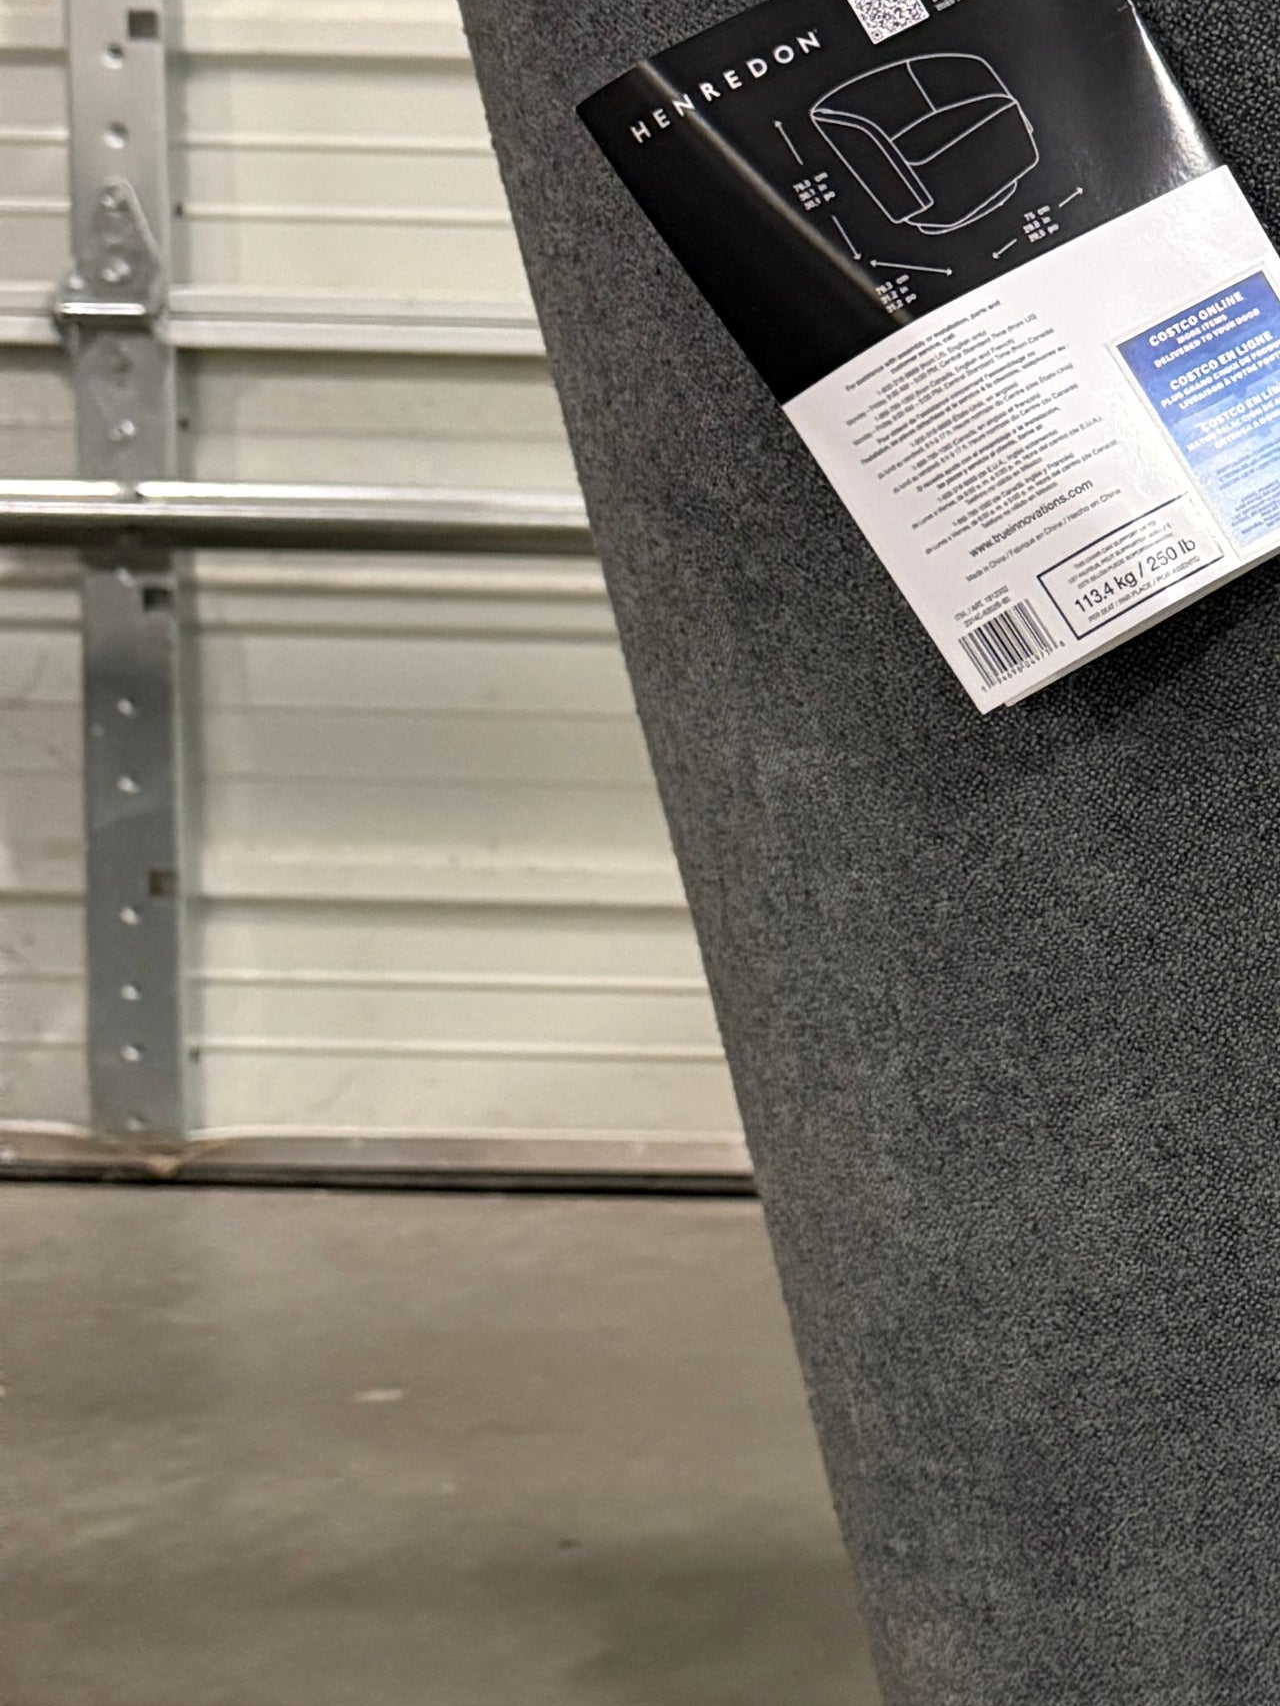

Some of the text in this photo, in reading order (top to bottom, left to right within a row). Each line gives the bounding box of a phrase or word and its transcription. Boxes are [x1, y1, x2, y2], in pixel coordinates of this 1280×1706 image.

[630, 31, 821, 144] HENREDON
[1148, 290, 1245, 347] COSTCO ONLINE
[1153, 339, 1202, 369] DELIVERED
[1200, 332, 1214, 343] TO
[1211, 320, 1237, 337] YOUR
[1169, 330, 1274, 391] COSTCO EN LIGNE
[1229, 362, 1259, 383] VOTRE
[1160, 391, 1185, 409] PLUS
[1197, 402, 1246, 434] COSTCO
[1243, 393, 1263, 410] EN
[968, 480, 1094, 558] www.trueinnovations.com
[965, 569, 984, 582] Made
[1074, 581, 1115, 613] 113.4
[1113, 571, 1138, 590] kg
[1138, 561, 1144, 579] /
[1146, 546, 1178, 572] 250
[1177, 538, 1196, 555] lb
